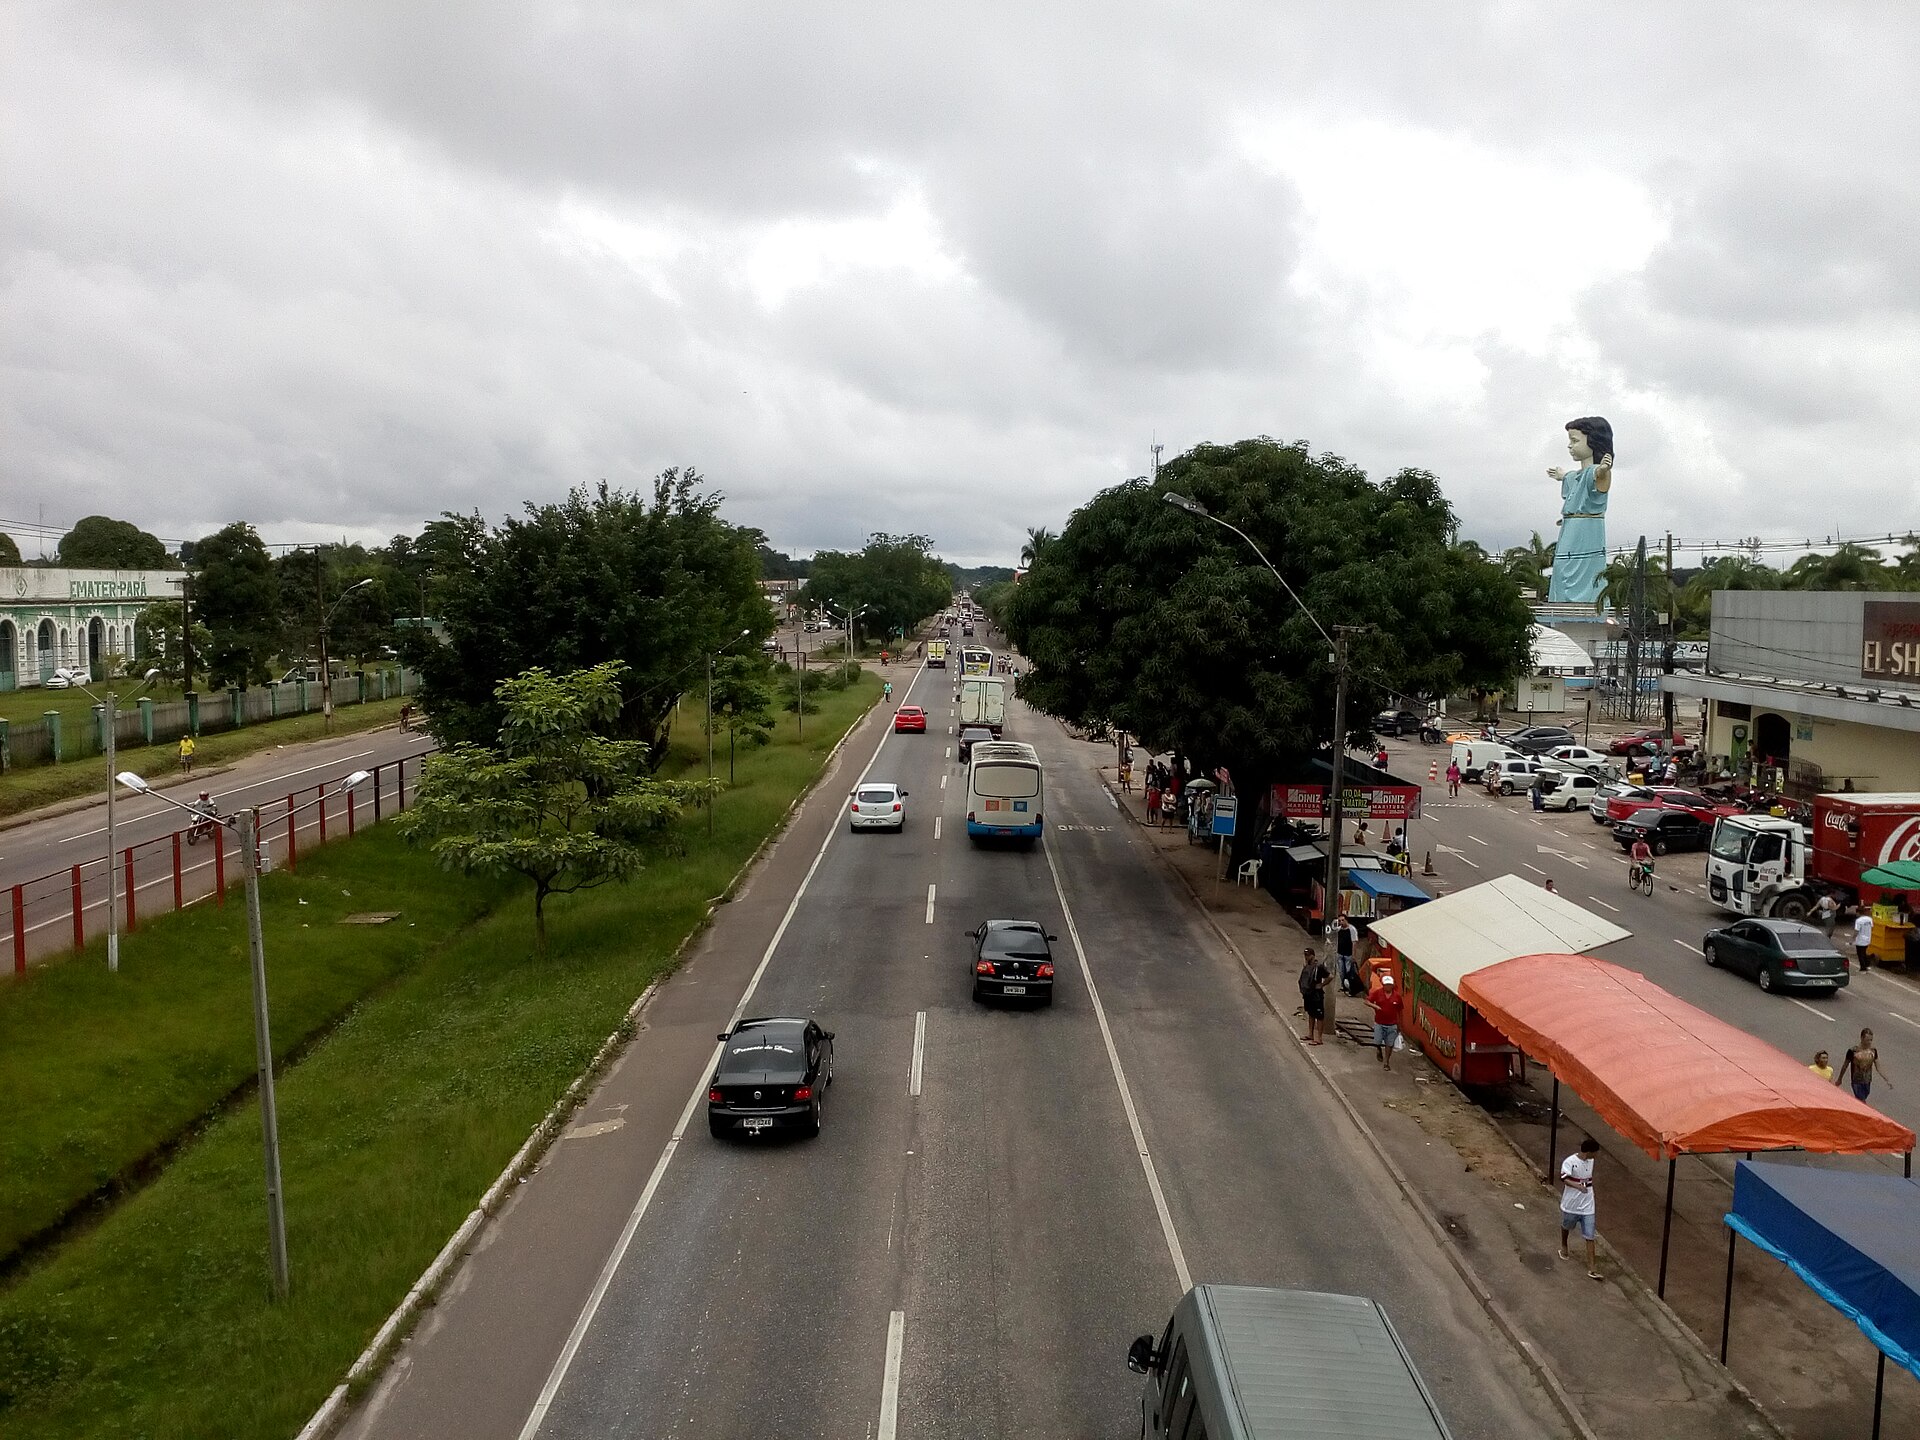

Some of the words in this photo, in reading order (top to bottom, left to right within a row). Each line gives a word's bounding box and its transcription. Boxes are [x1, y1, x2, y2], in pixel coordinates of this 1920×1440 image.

[69, 577, 147, 598] EMATER-PARÁ
[1299, 794, 1321, 803] DINIZ
[1384, 795, 1405, 803] DINIZ
